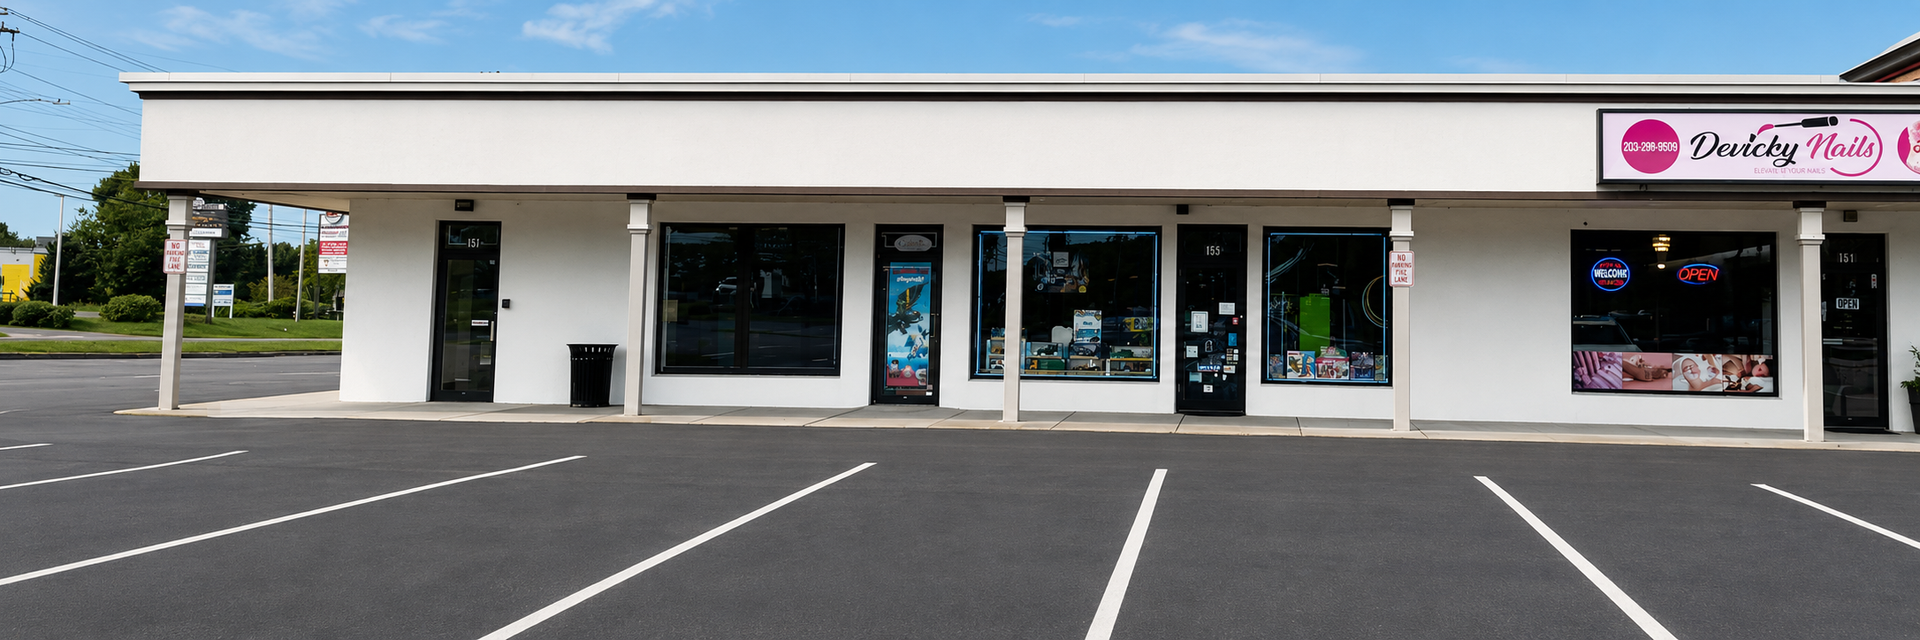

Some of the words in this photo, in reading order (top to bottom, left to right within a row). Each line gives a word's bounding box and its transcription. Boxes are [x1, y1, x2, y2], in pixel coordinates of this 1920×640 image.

[1690, 131, 1799, 168] Devicky
[1805, 132, 1875, 161] Nails
[467, 237, 480, 248] 151
[1206, 245, 1221, 256] 155
[1397, 253, 1407, 261] NO
[1839, 252, 1854, 263] 151
[1594, 268, 1628, 279] WELCOME
[1678, 267, 1720, 281] OPEN
[1838, 298, 1858, 309] OPEN
